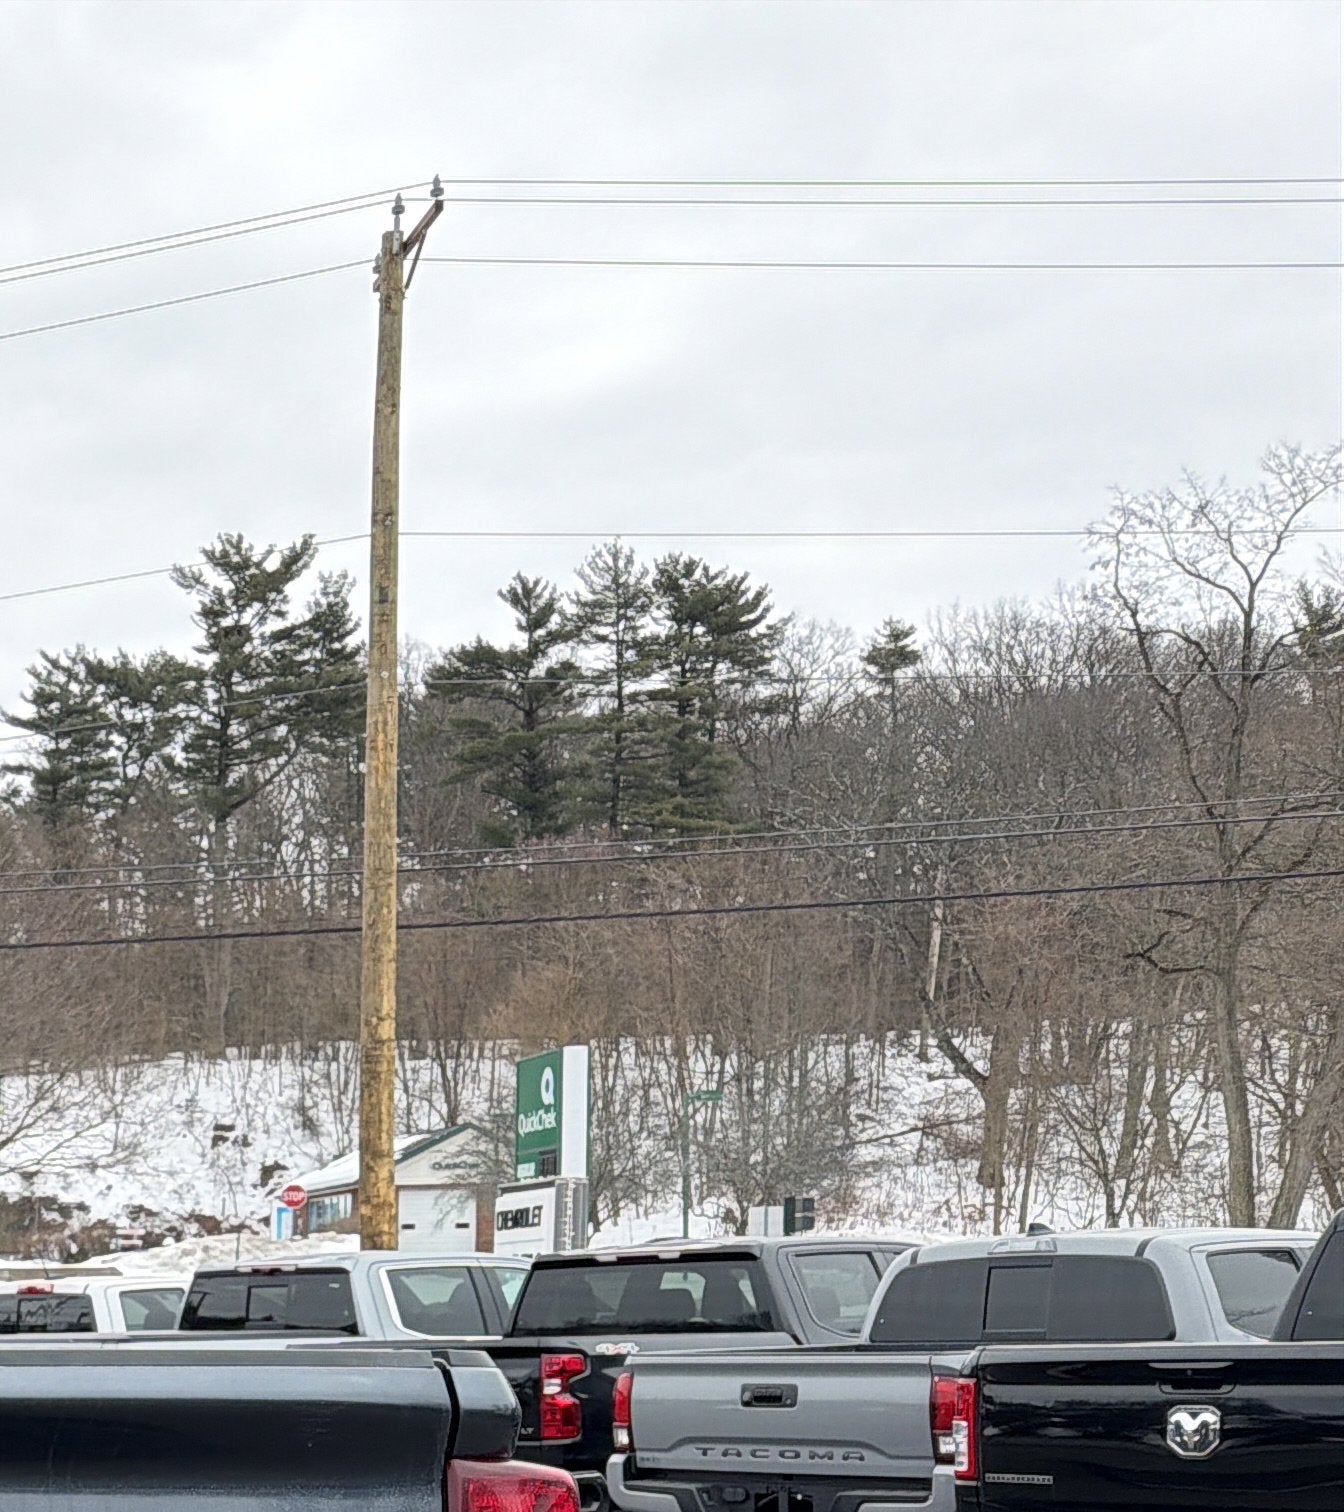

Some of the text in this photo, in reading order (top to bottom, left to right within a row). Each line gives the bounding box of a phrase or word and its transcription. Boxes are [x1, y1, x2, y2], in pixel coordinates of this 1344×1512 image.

[518, 1106, 557, 1137] QuickChek
[283, 1190, 306, 1202] STOP
[695, 1447, 865, 1462] TACOMA
